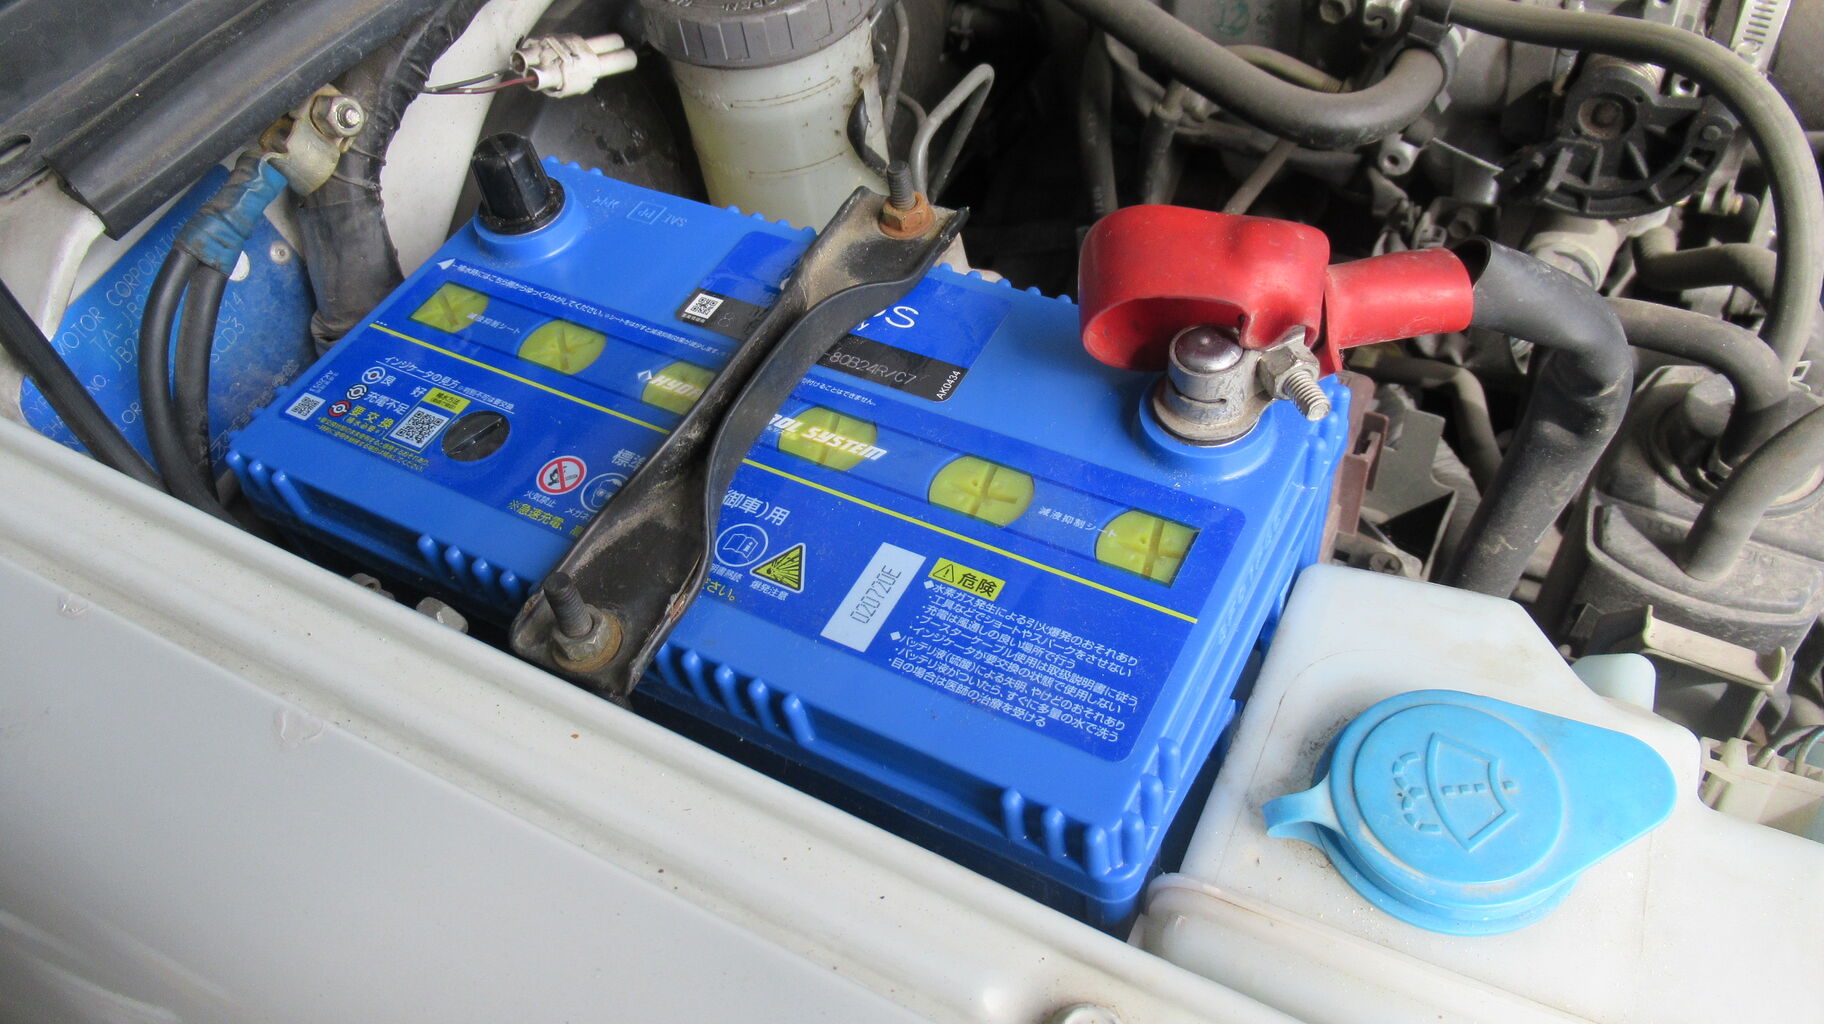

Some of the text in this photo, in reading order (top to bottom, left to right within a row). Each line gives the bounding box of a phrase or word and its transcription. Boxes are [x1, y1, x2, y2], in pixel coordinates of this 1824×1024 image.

[384, 356, 461, 389] インジケータの見方
[936, 370, 961, 400] AK0434
[364, 391, 410, 415] 充電不足
[802, 426, 888, 460] SYSTEM
[1038, 506, 1118, 537] 減液抑制シート
[523, 489, 556, 508] 火気禁止
[750, 579, 789, 602] 爆発注意
[850, 564, 902, 624] 020720E
[959, 572, 999, 598] 危険
